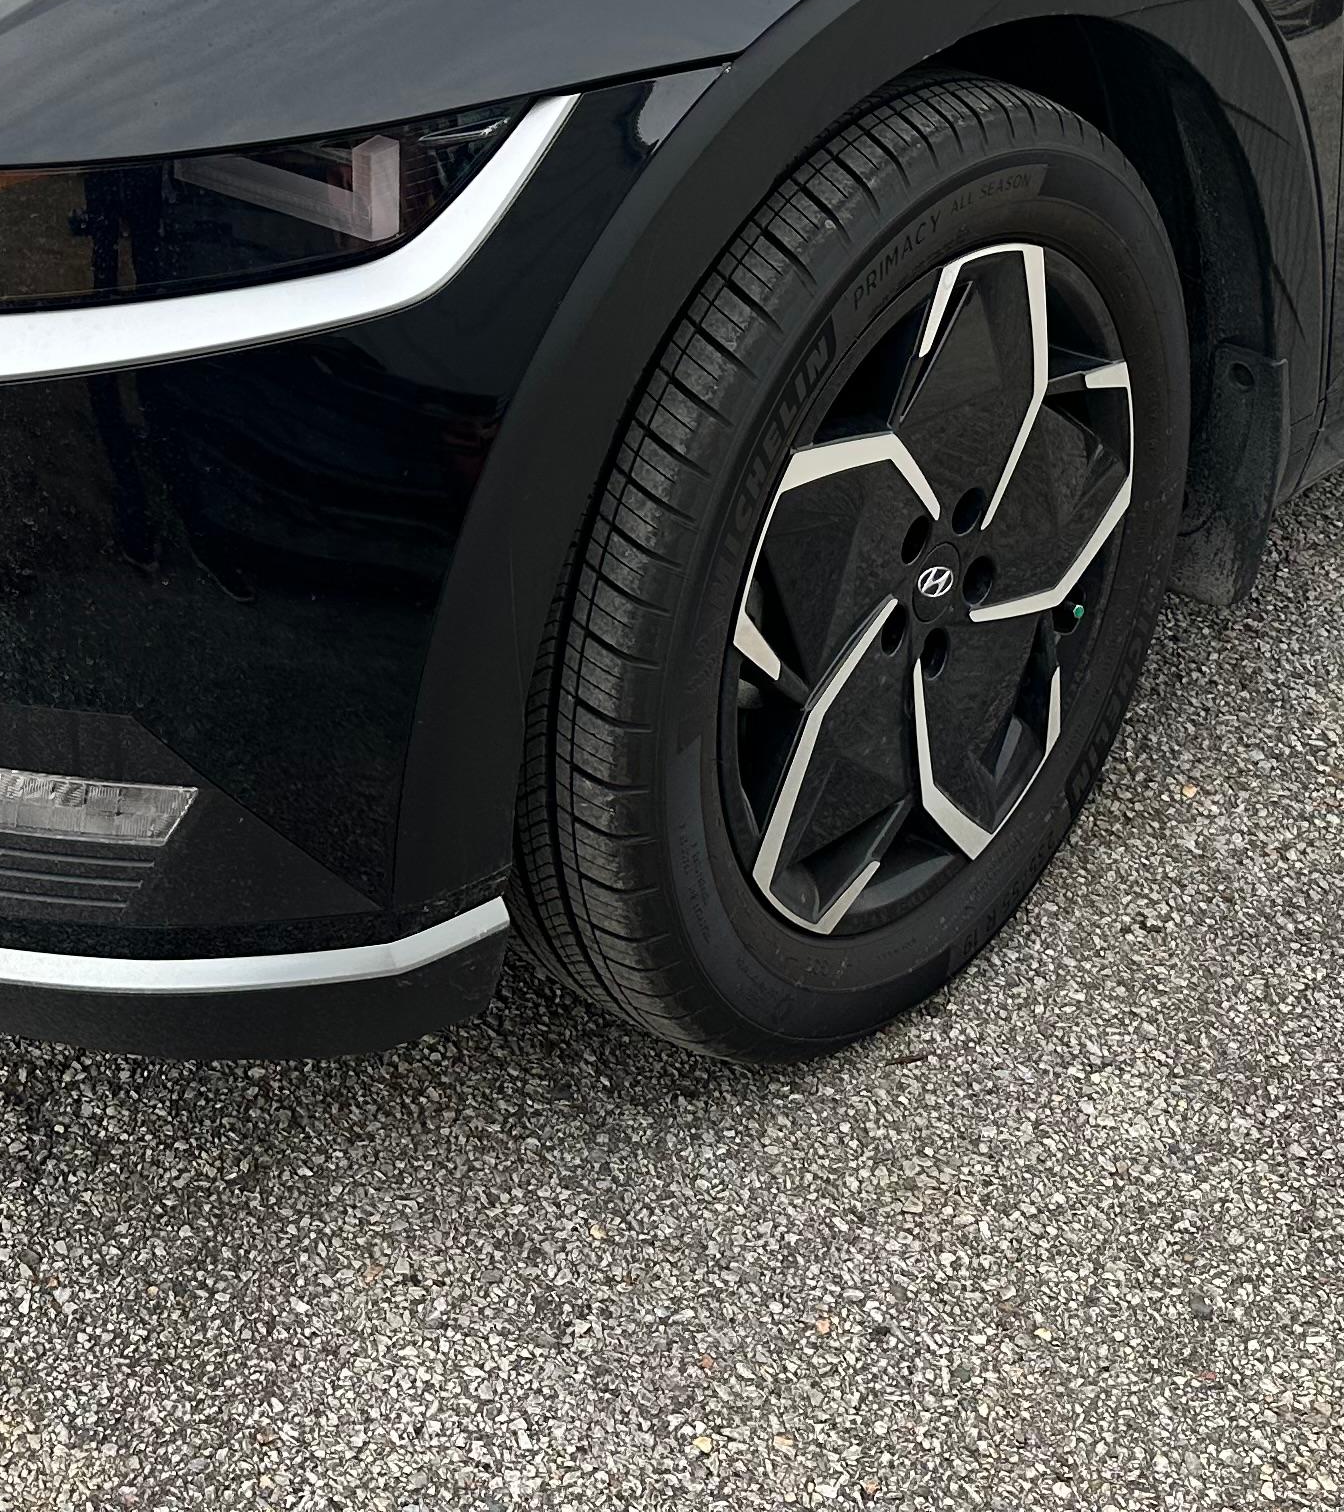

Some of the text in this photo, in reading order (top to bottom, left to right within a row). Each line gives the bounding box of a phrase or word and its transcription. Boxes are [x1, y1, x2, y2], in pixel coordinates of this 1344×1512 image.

[854, 174, 1032, 310] PRIMACY ALL SEASON
[708, 334, 828, 612] MICHELIN
